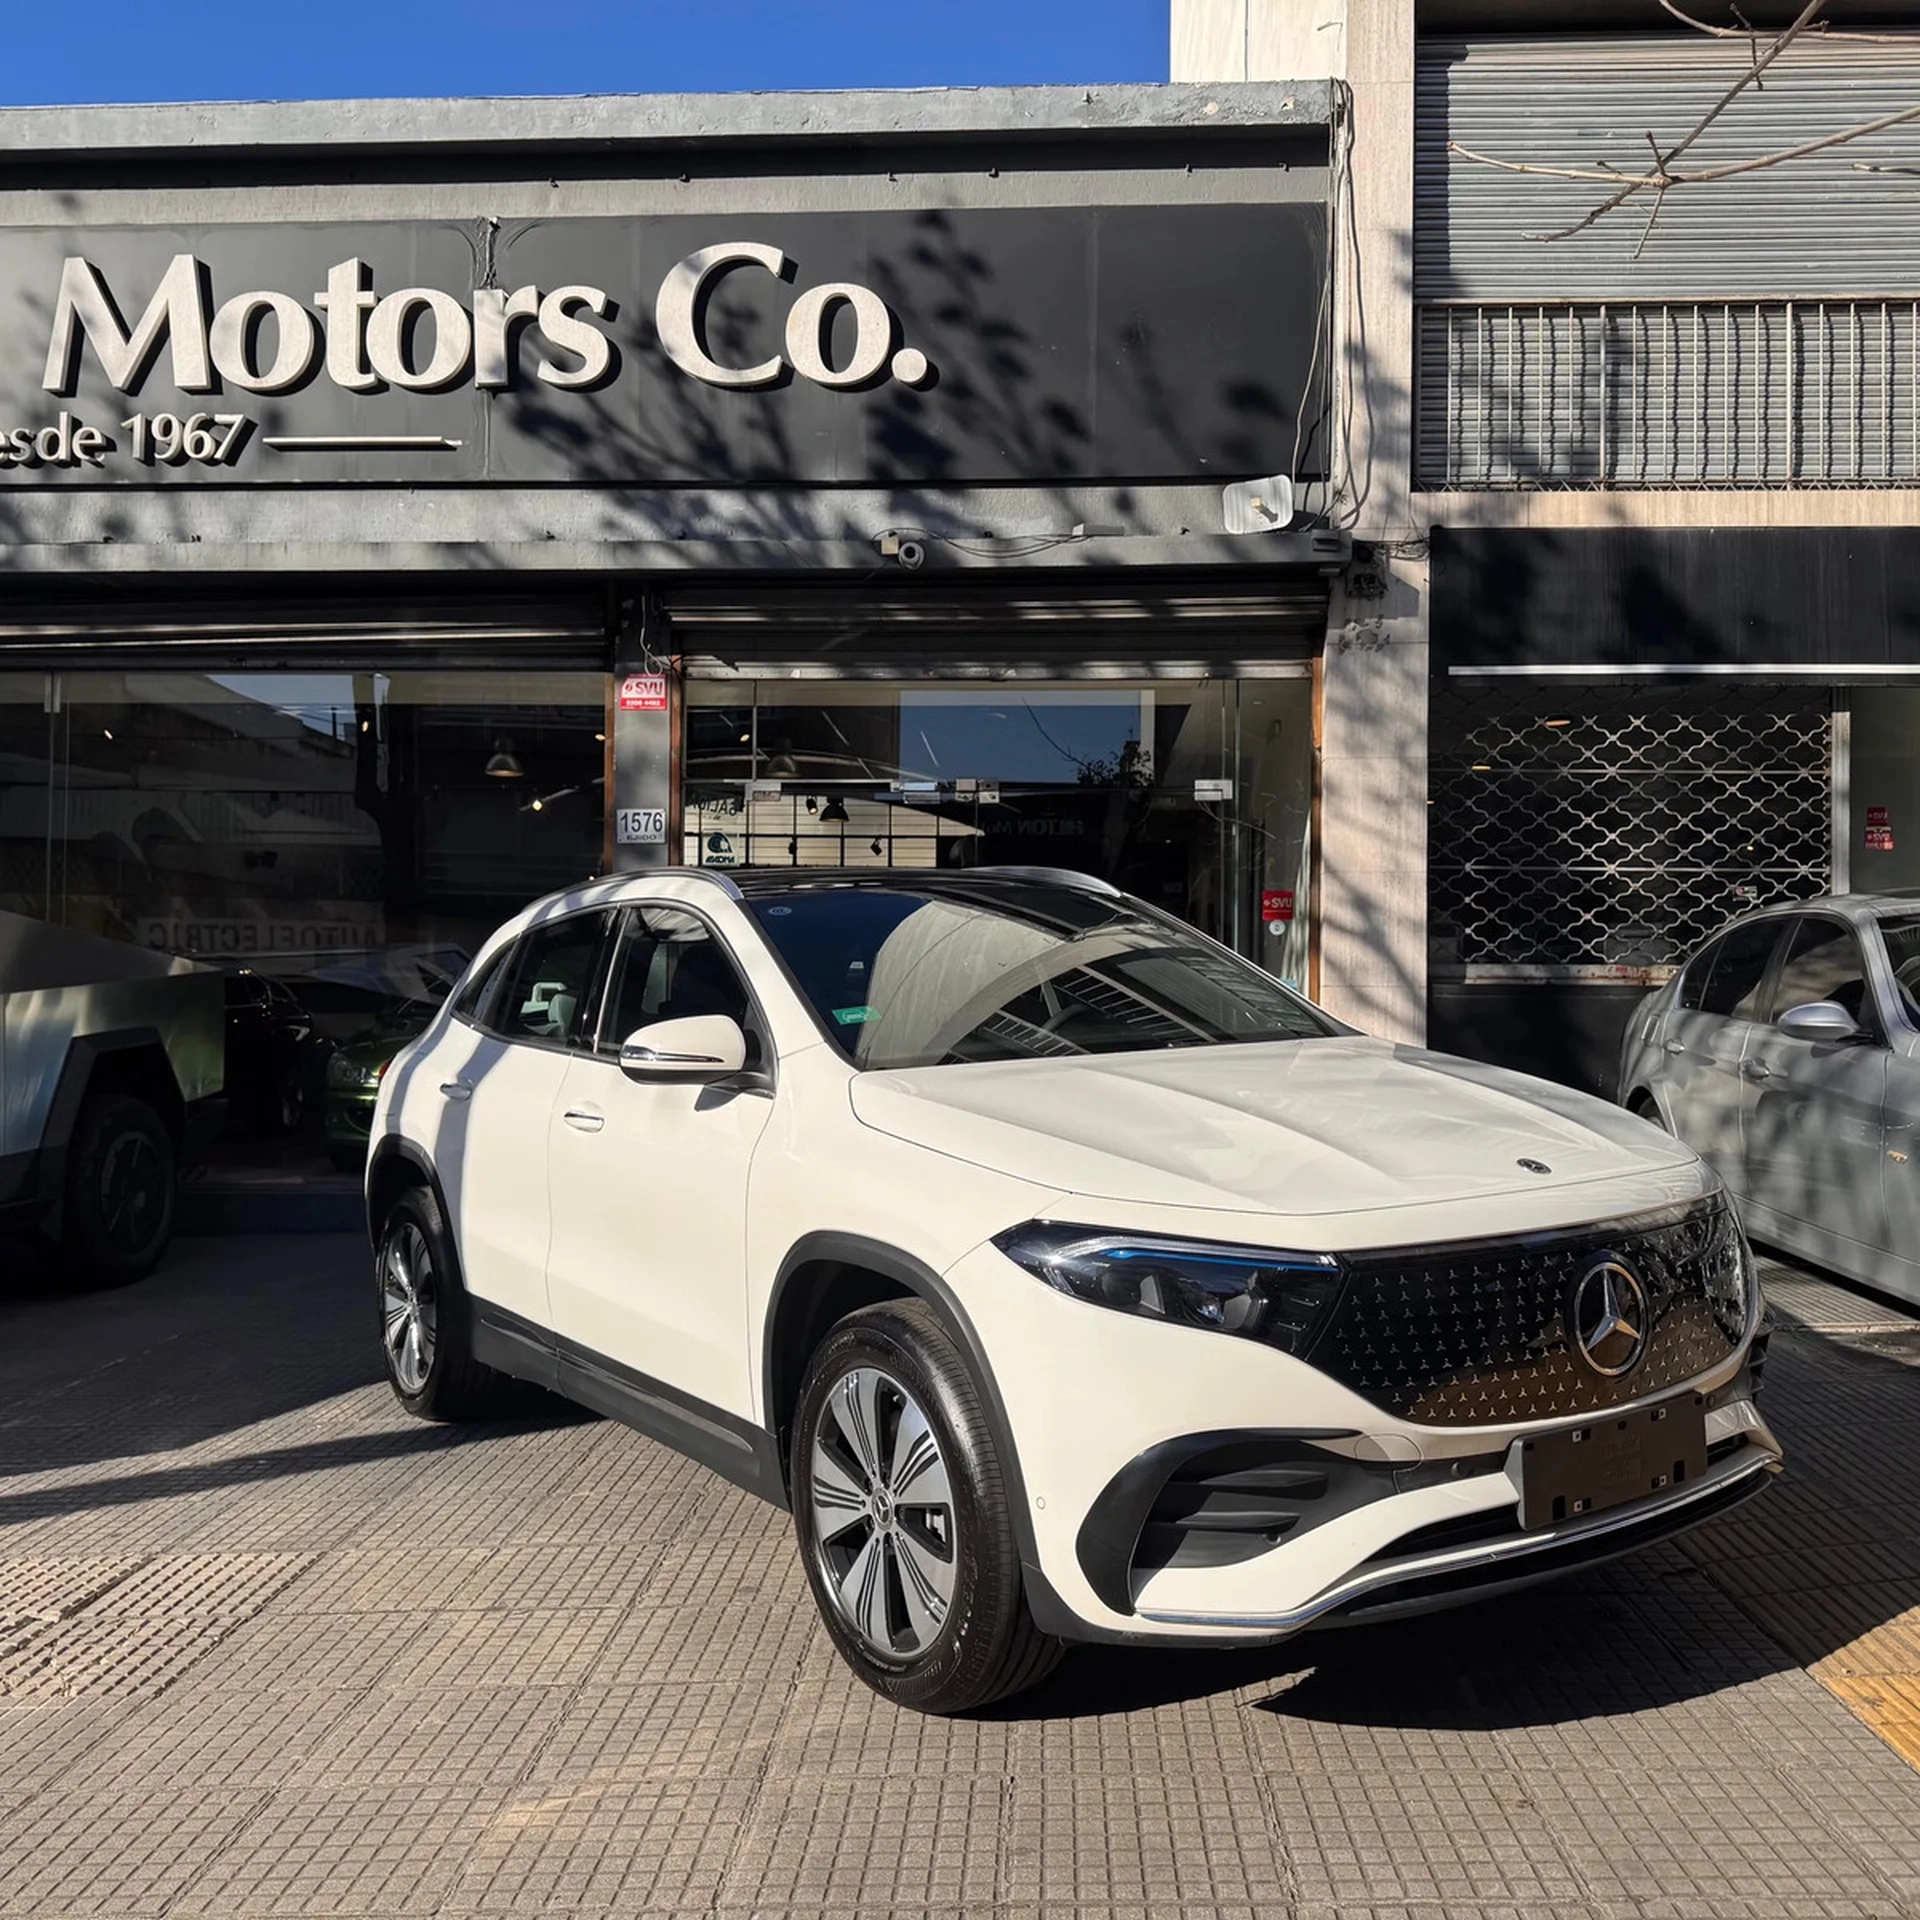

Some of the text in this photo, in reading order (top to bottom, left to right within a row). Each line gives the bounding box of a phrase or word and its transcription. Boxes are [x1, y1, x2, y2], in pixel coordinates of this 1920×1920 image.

[42, 242, 930, 391] Motors Co.
[0, 411, 247, 462] sde 1967
[635, 681, 663, 695] SVU
[620, 812, 663, 833] 1576
[1271, 897, 1292, 909] SVU
